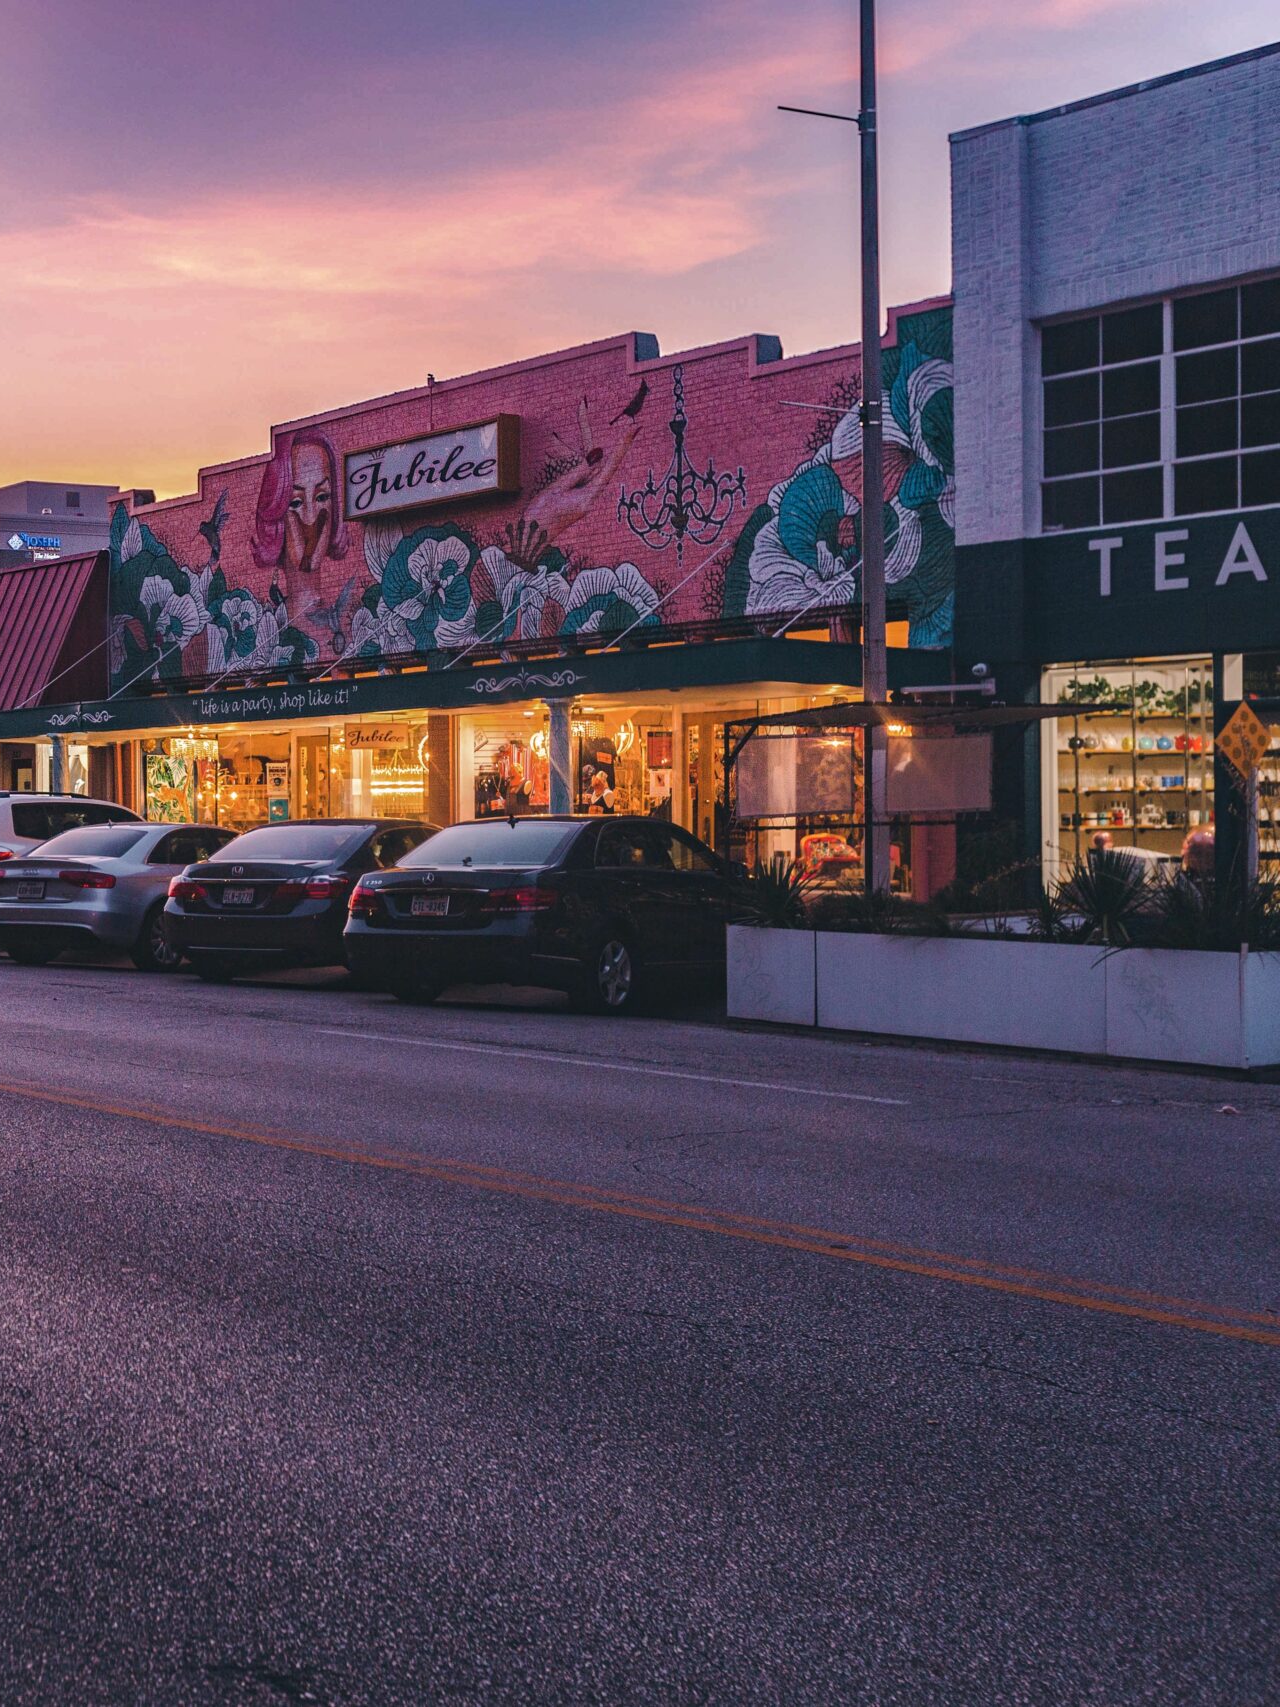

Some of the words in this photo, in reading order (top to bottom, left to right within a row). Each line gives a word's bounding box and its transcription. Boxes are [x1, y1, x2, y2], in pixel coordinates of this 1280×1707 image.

[350, 445, 496, 510] Jubilee
[26, 537, 61, 546] JOSEPH
[1088, 521, 1268, 596] TEA
[221, 700, 230, 714] is
[231, 700, 241, 712] a
[280, 692, 306, 712] shop
[308, 690, 332, 706] like
[347, 729, 405, 747] Jubilee
